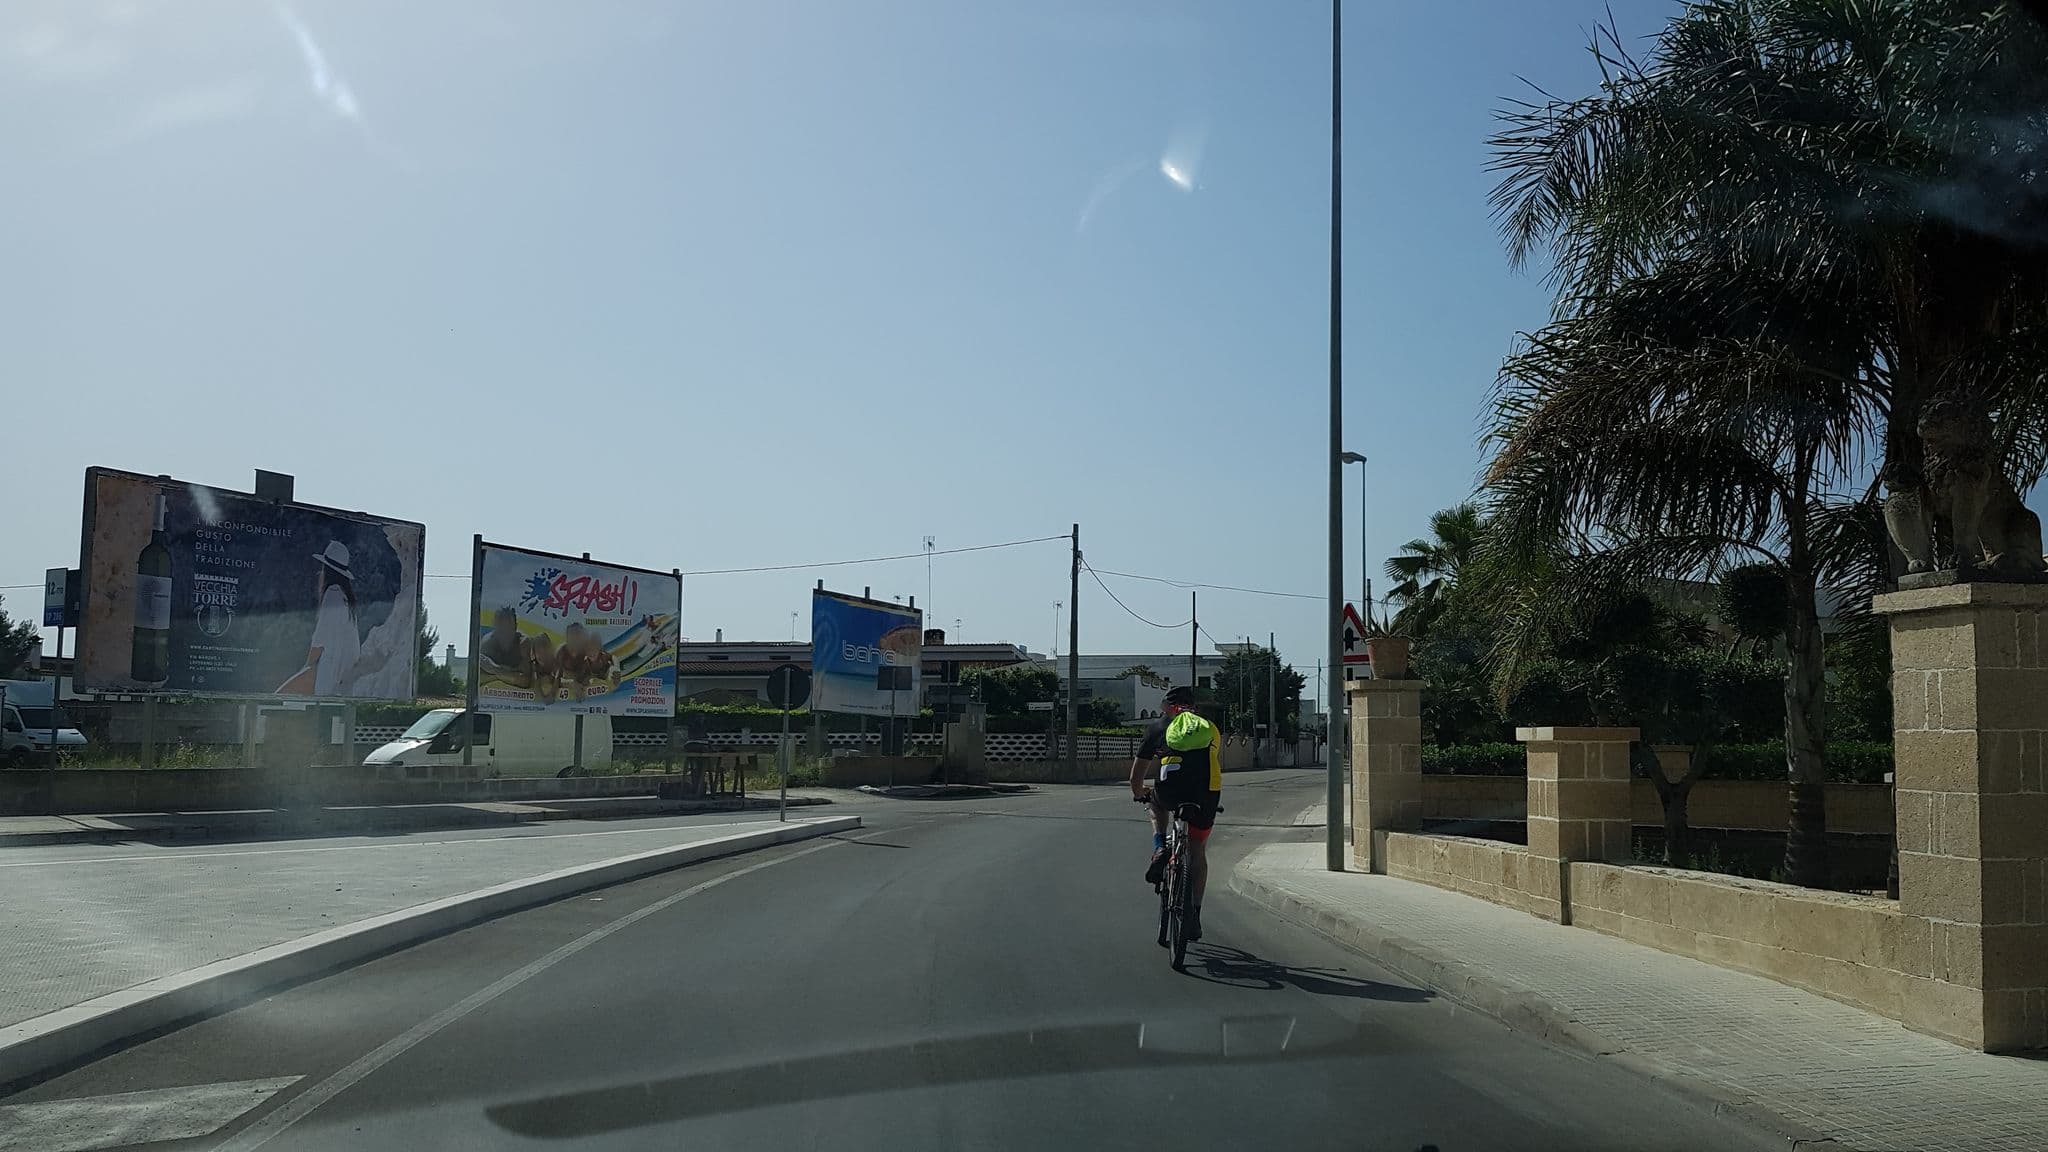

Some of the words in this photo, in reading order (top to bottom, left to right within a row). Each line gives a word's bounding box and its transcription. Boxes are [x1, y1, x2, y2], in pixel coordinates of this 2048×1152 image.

[196, 529, 232, 542] GUSTO
[195, 541, 225, 553] DELLA
[195, 554, 257, 569] TRADIZIONE
[193, 580, 238, 594] VECCHIA
[193, 592, 238, 607] TORRE
[559, 689, 569, 700] 49
